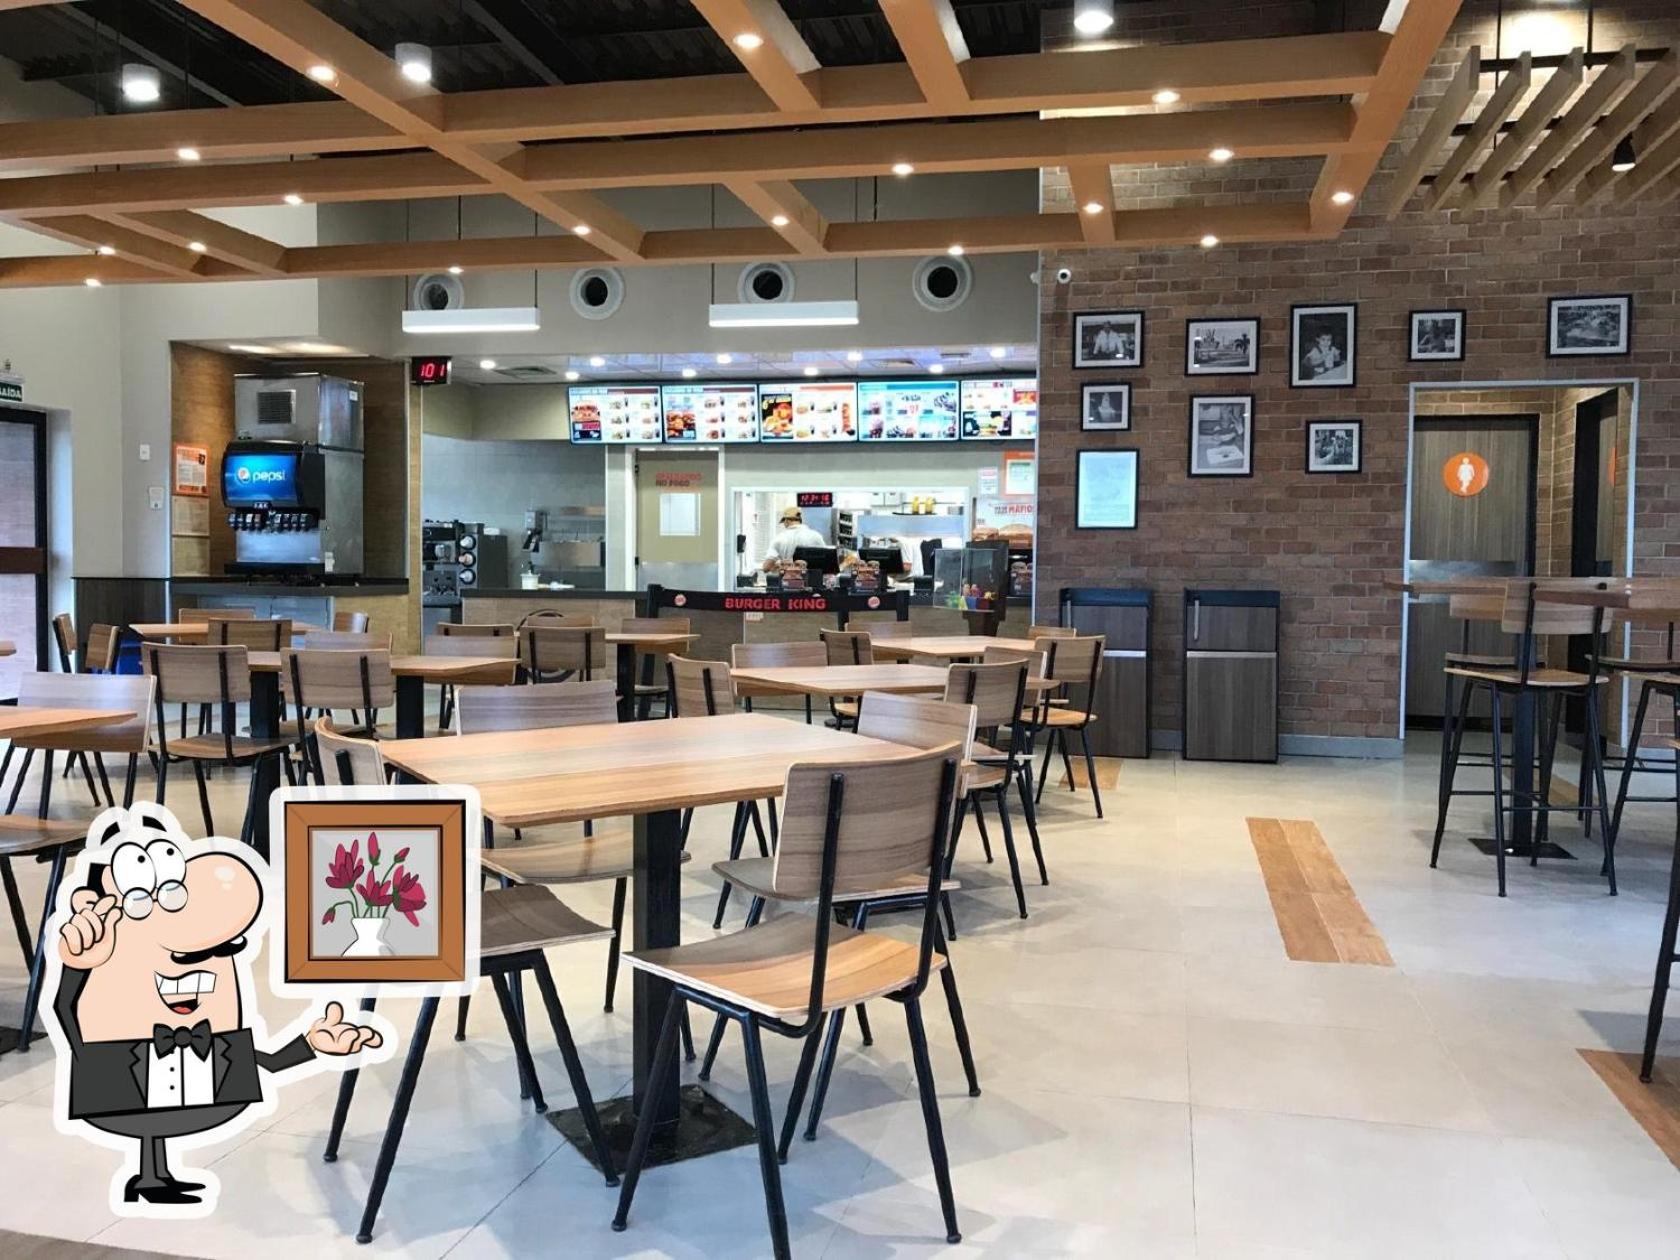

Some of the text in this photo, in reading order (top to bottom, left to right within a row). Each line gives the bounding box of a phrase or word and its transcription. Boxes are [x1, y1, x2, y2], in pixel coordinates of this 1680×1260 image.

[421, 363, 445, 378] 101
[0, 386, 22, 398] AÍDA
[252, 469, 286, 484] pepsi
[725, 597, 826, 610] BURGER KING
